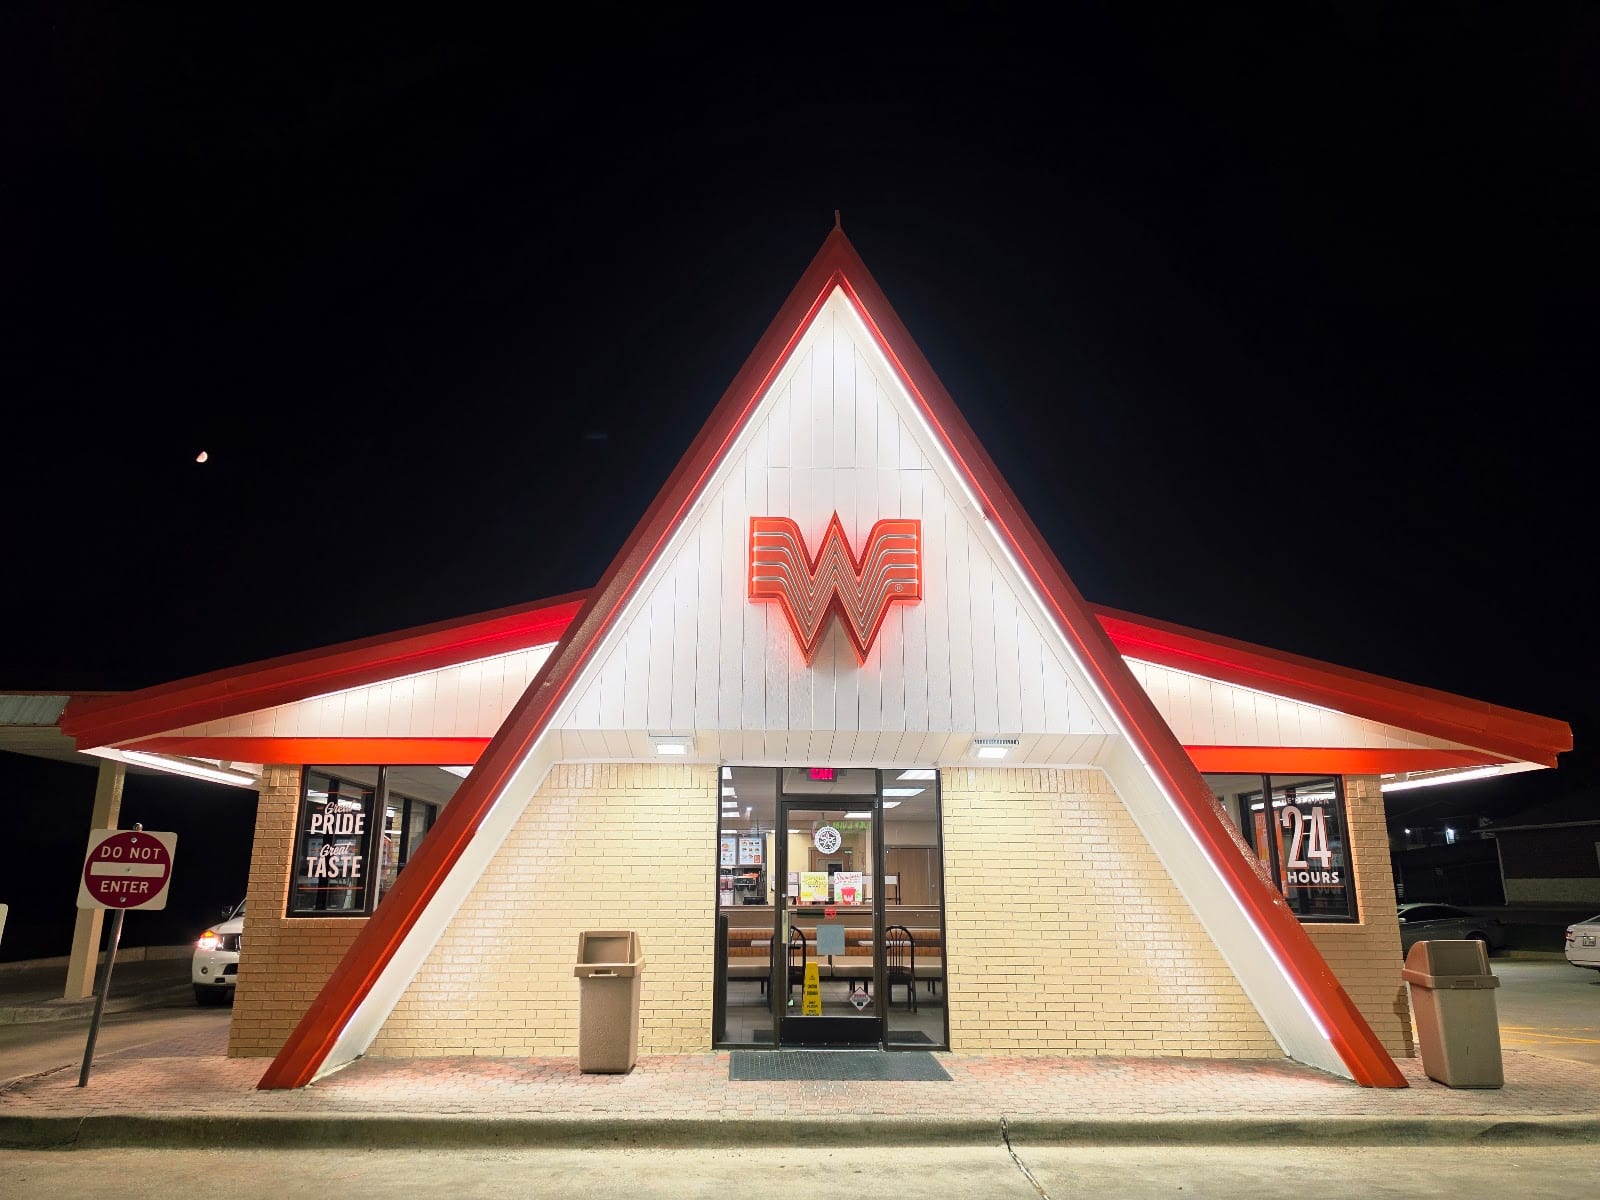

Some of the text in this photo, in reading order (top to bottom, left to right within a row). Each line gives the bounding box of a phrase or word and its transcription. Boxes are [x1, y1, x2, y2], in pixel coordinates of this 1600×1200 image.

[748, 509, 922, 666] W
[310, 813, 366, 834] PRIDE
[1281, 806, 1333, 868] 24
[101, 846, 161, 859] DO NOT
[320, 842, 351, 857] Great
[306, 855, 363, 878] TASTE
[1287, 871, 1340, 884] HOURS
[100, 881, 149, 893] ENTER
